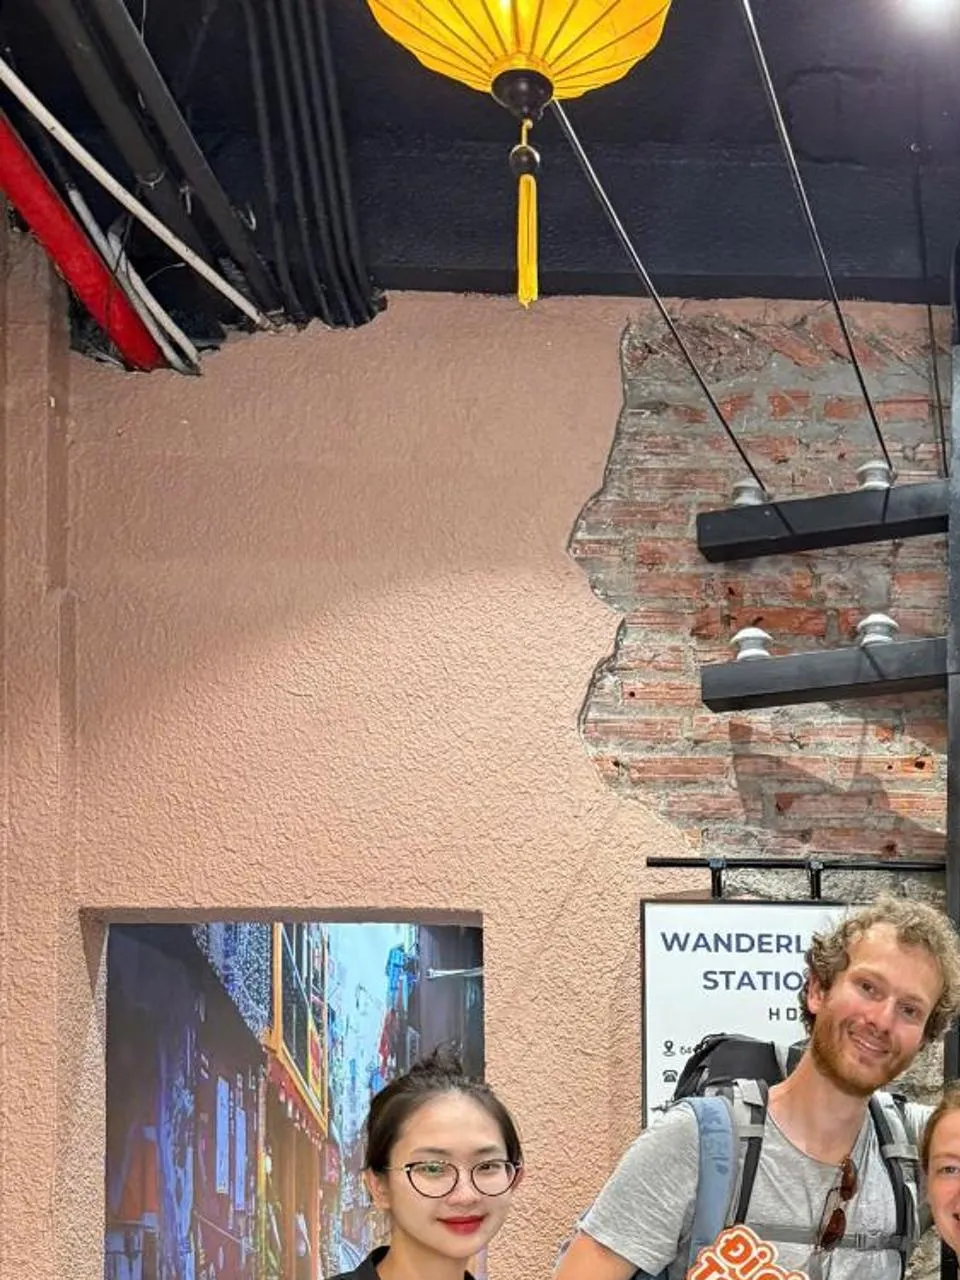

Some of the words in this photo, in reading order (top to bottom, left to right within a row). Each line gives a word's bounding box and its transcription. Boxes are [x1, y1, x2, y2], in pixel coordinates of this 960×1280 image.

[660, 931, 806, 954] WANDERL
[702, 970, 804, 991] STATIO
[769, 1007, 798, 1021] HO
[719, 1234, 767, 1277] Đi
